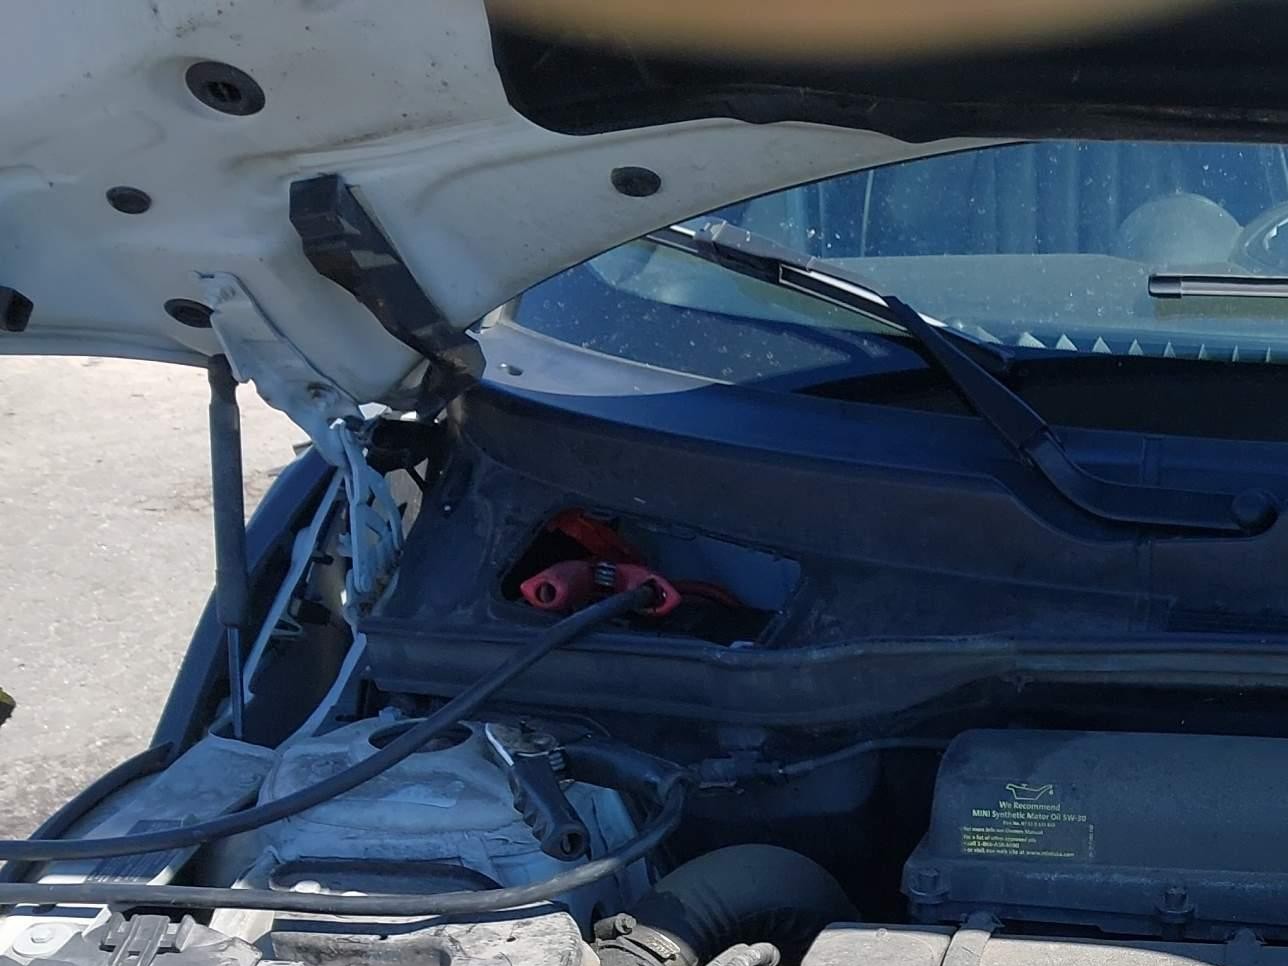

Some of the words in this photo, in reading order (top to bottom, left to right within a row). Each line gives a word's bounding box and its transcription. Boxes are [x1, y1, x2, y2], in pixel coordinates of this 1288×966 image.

[999, 800, 1012, 809] We
[1013, 801, 1061, 811] Recommend
[972, 809, 991, 817] MINI
[991, 810, 1026, 820] Synthetic
[1026, 812, 1049, 820] Motor
[1050, 813, 1061, 821] Oil
[1062, 814, 1086, 822] 5W-30
